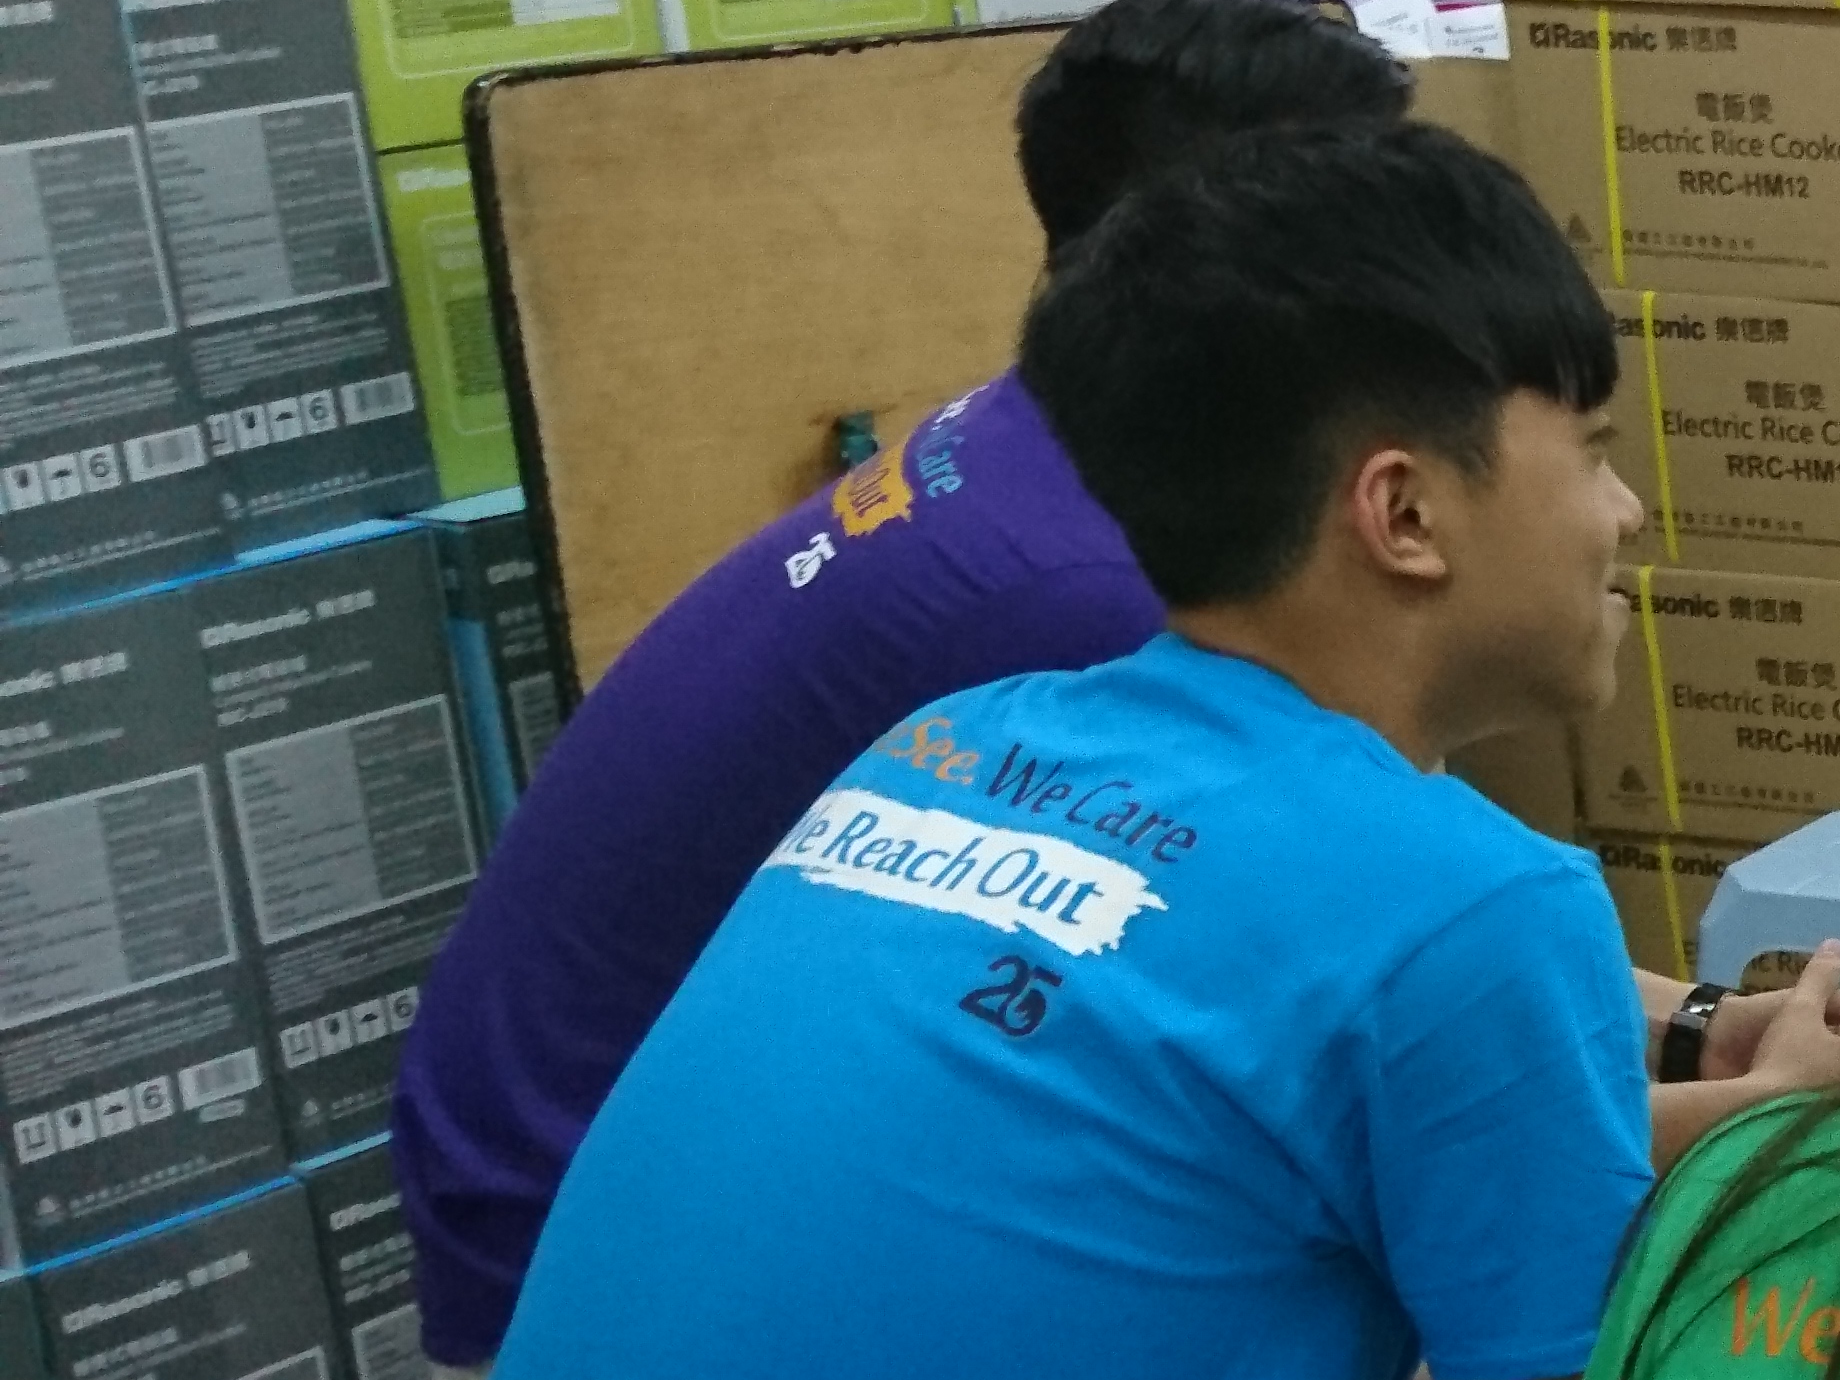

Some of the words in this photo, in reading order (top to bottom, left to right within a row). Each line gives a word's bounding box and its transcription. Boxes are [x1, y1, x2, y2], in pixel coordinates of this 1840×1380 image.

[1616, 126, 1705, 155] Electric
[1711, 130, 1763, 157] Rice
[1679, 170, 1810, 199] RRC-HM12
[1616, 313, 1706, 340] asonic
[1663, 410, 1754, 440] Electric
[1761, 417, 1814, 444] Rice
[1672, 685, 1762, 716] Electric
[1772, 694, 1825, 720] Rice
[986, 743, 1073, 815] We
[1066, 781, 1197, 865] Care
[823, 810, 980, 892] Reach
[976, 847, 1103, 925] Out
